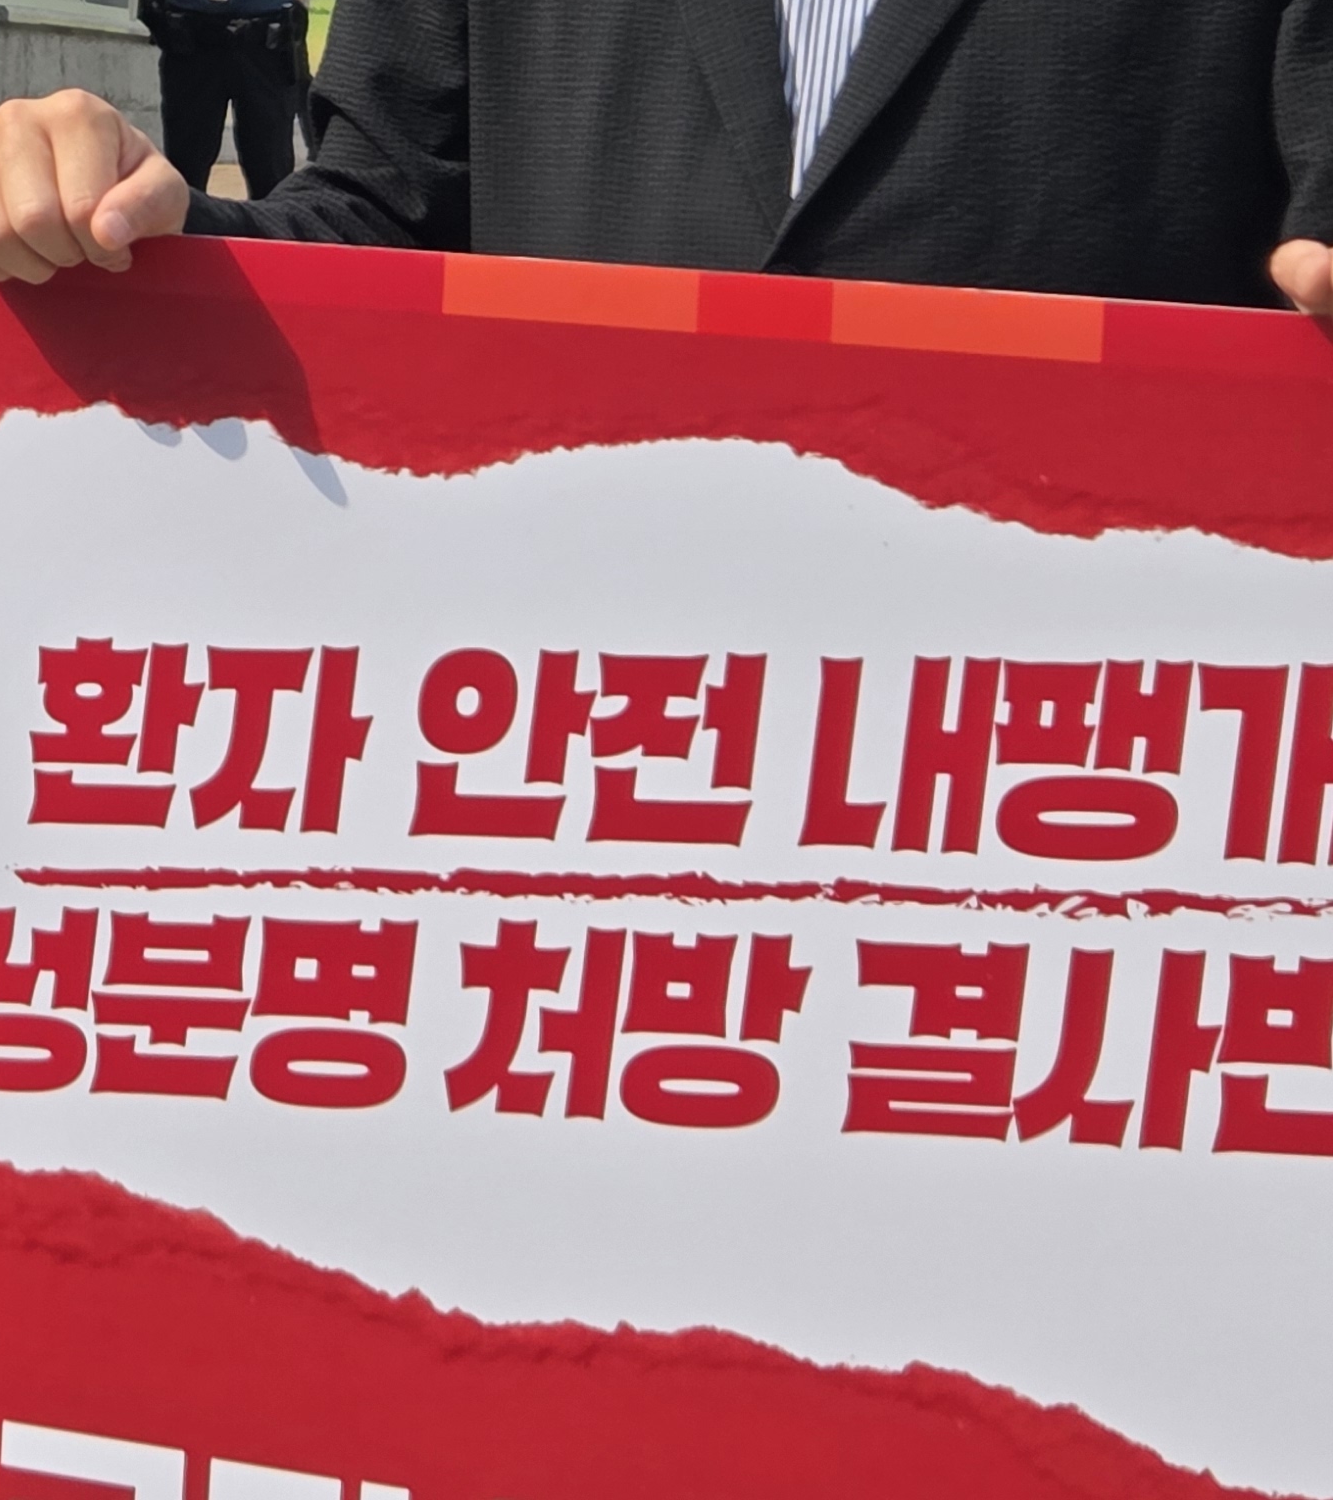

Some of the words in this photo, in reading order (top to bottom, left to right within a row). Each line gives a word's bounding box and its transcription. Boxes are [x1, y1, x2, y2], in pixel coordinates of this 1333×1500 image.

[27, 637, 374, 834] 환자
[408, 648, 767, 847] 안전
[443, 918, 813, 1129] 처방
